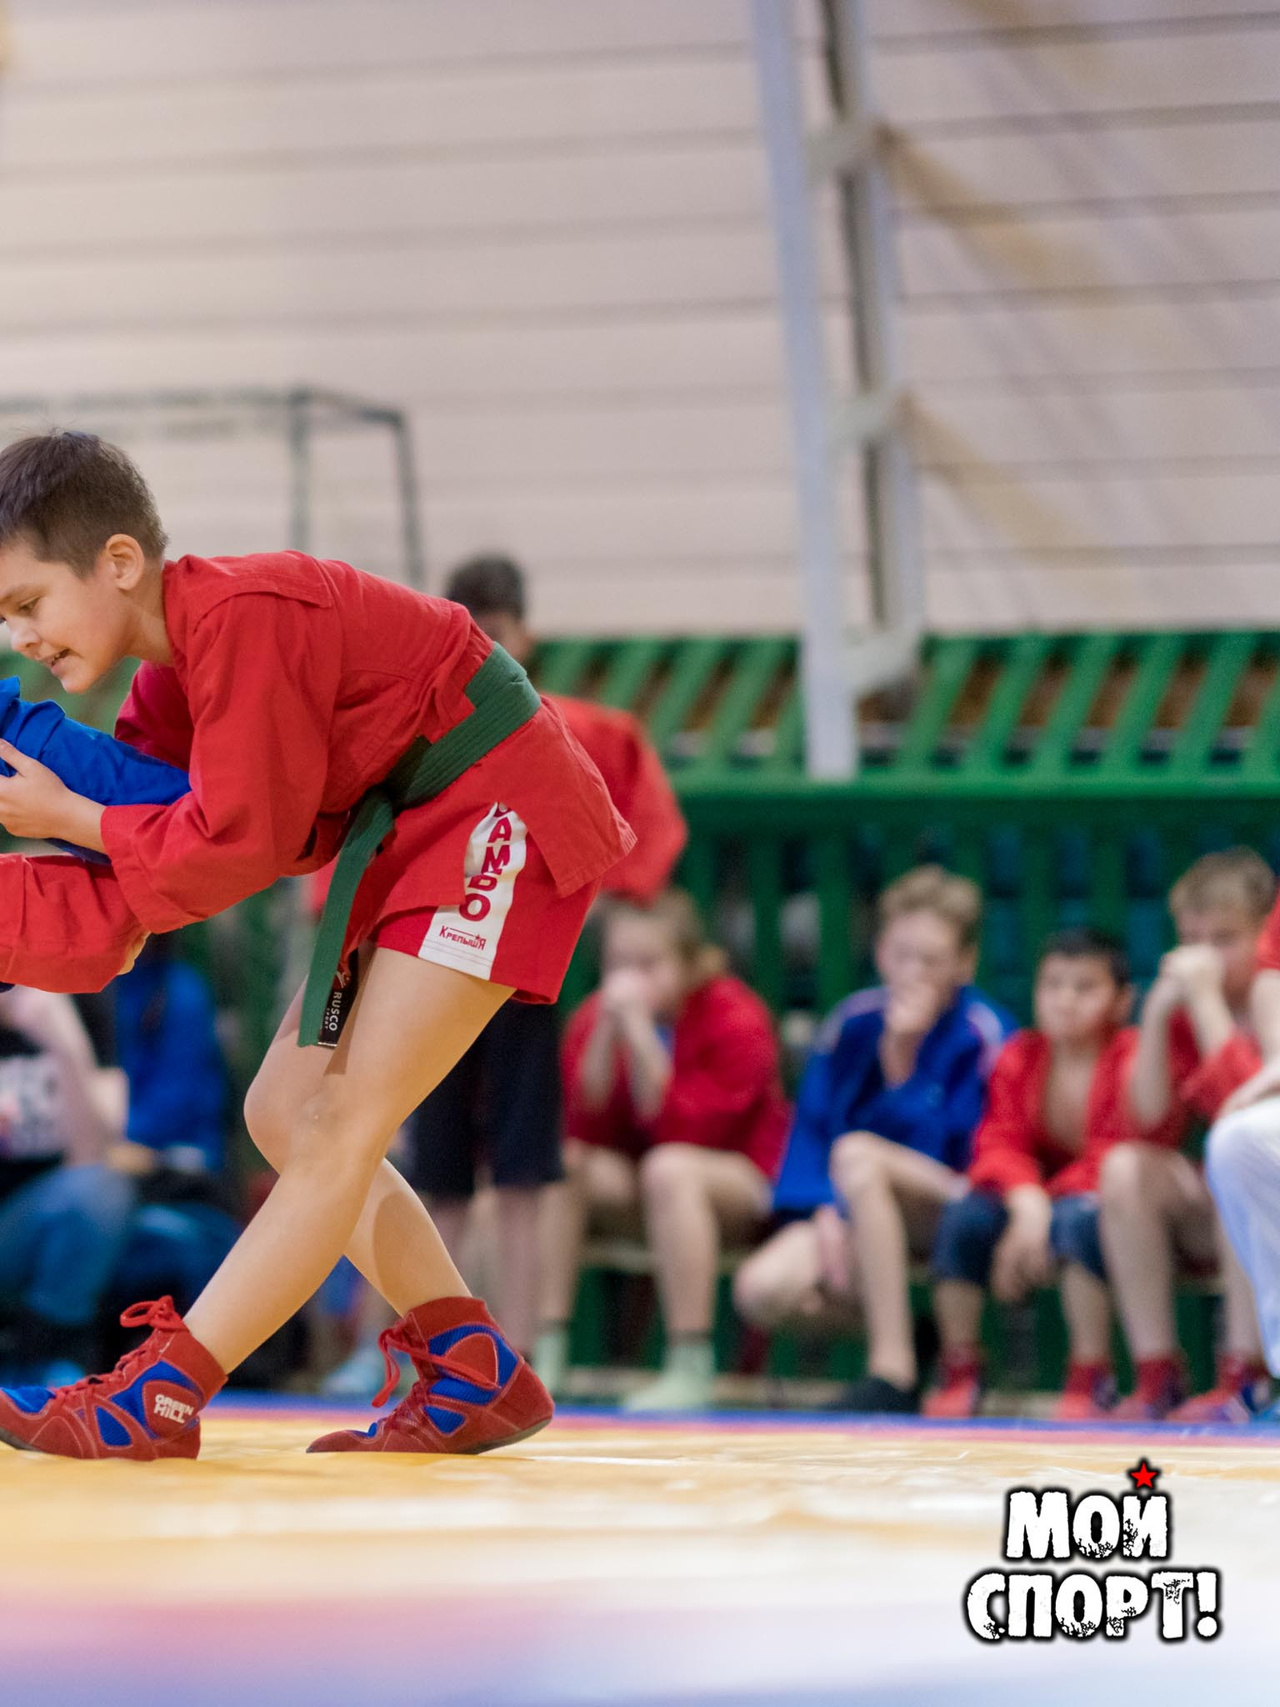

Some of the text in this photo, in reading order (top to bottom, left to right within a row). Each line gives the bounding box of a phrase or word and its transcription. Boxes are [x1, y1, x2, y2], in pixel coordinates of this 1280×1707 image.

[329, 991, 343, 1032] RUSCO
[153, 1403, 186, 1425] HILL
[155, 1393, 195, 1416] GREEN
